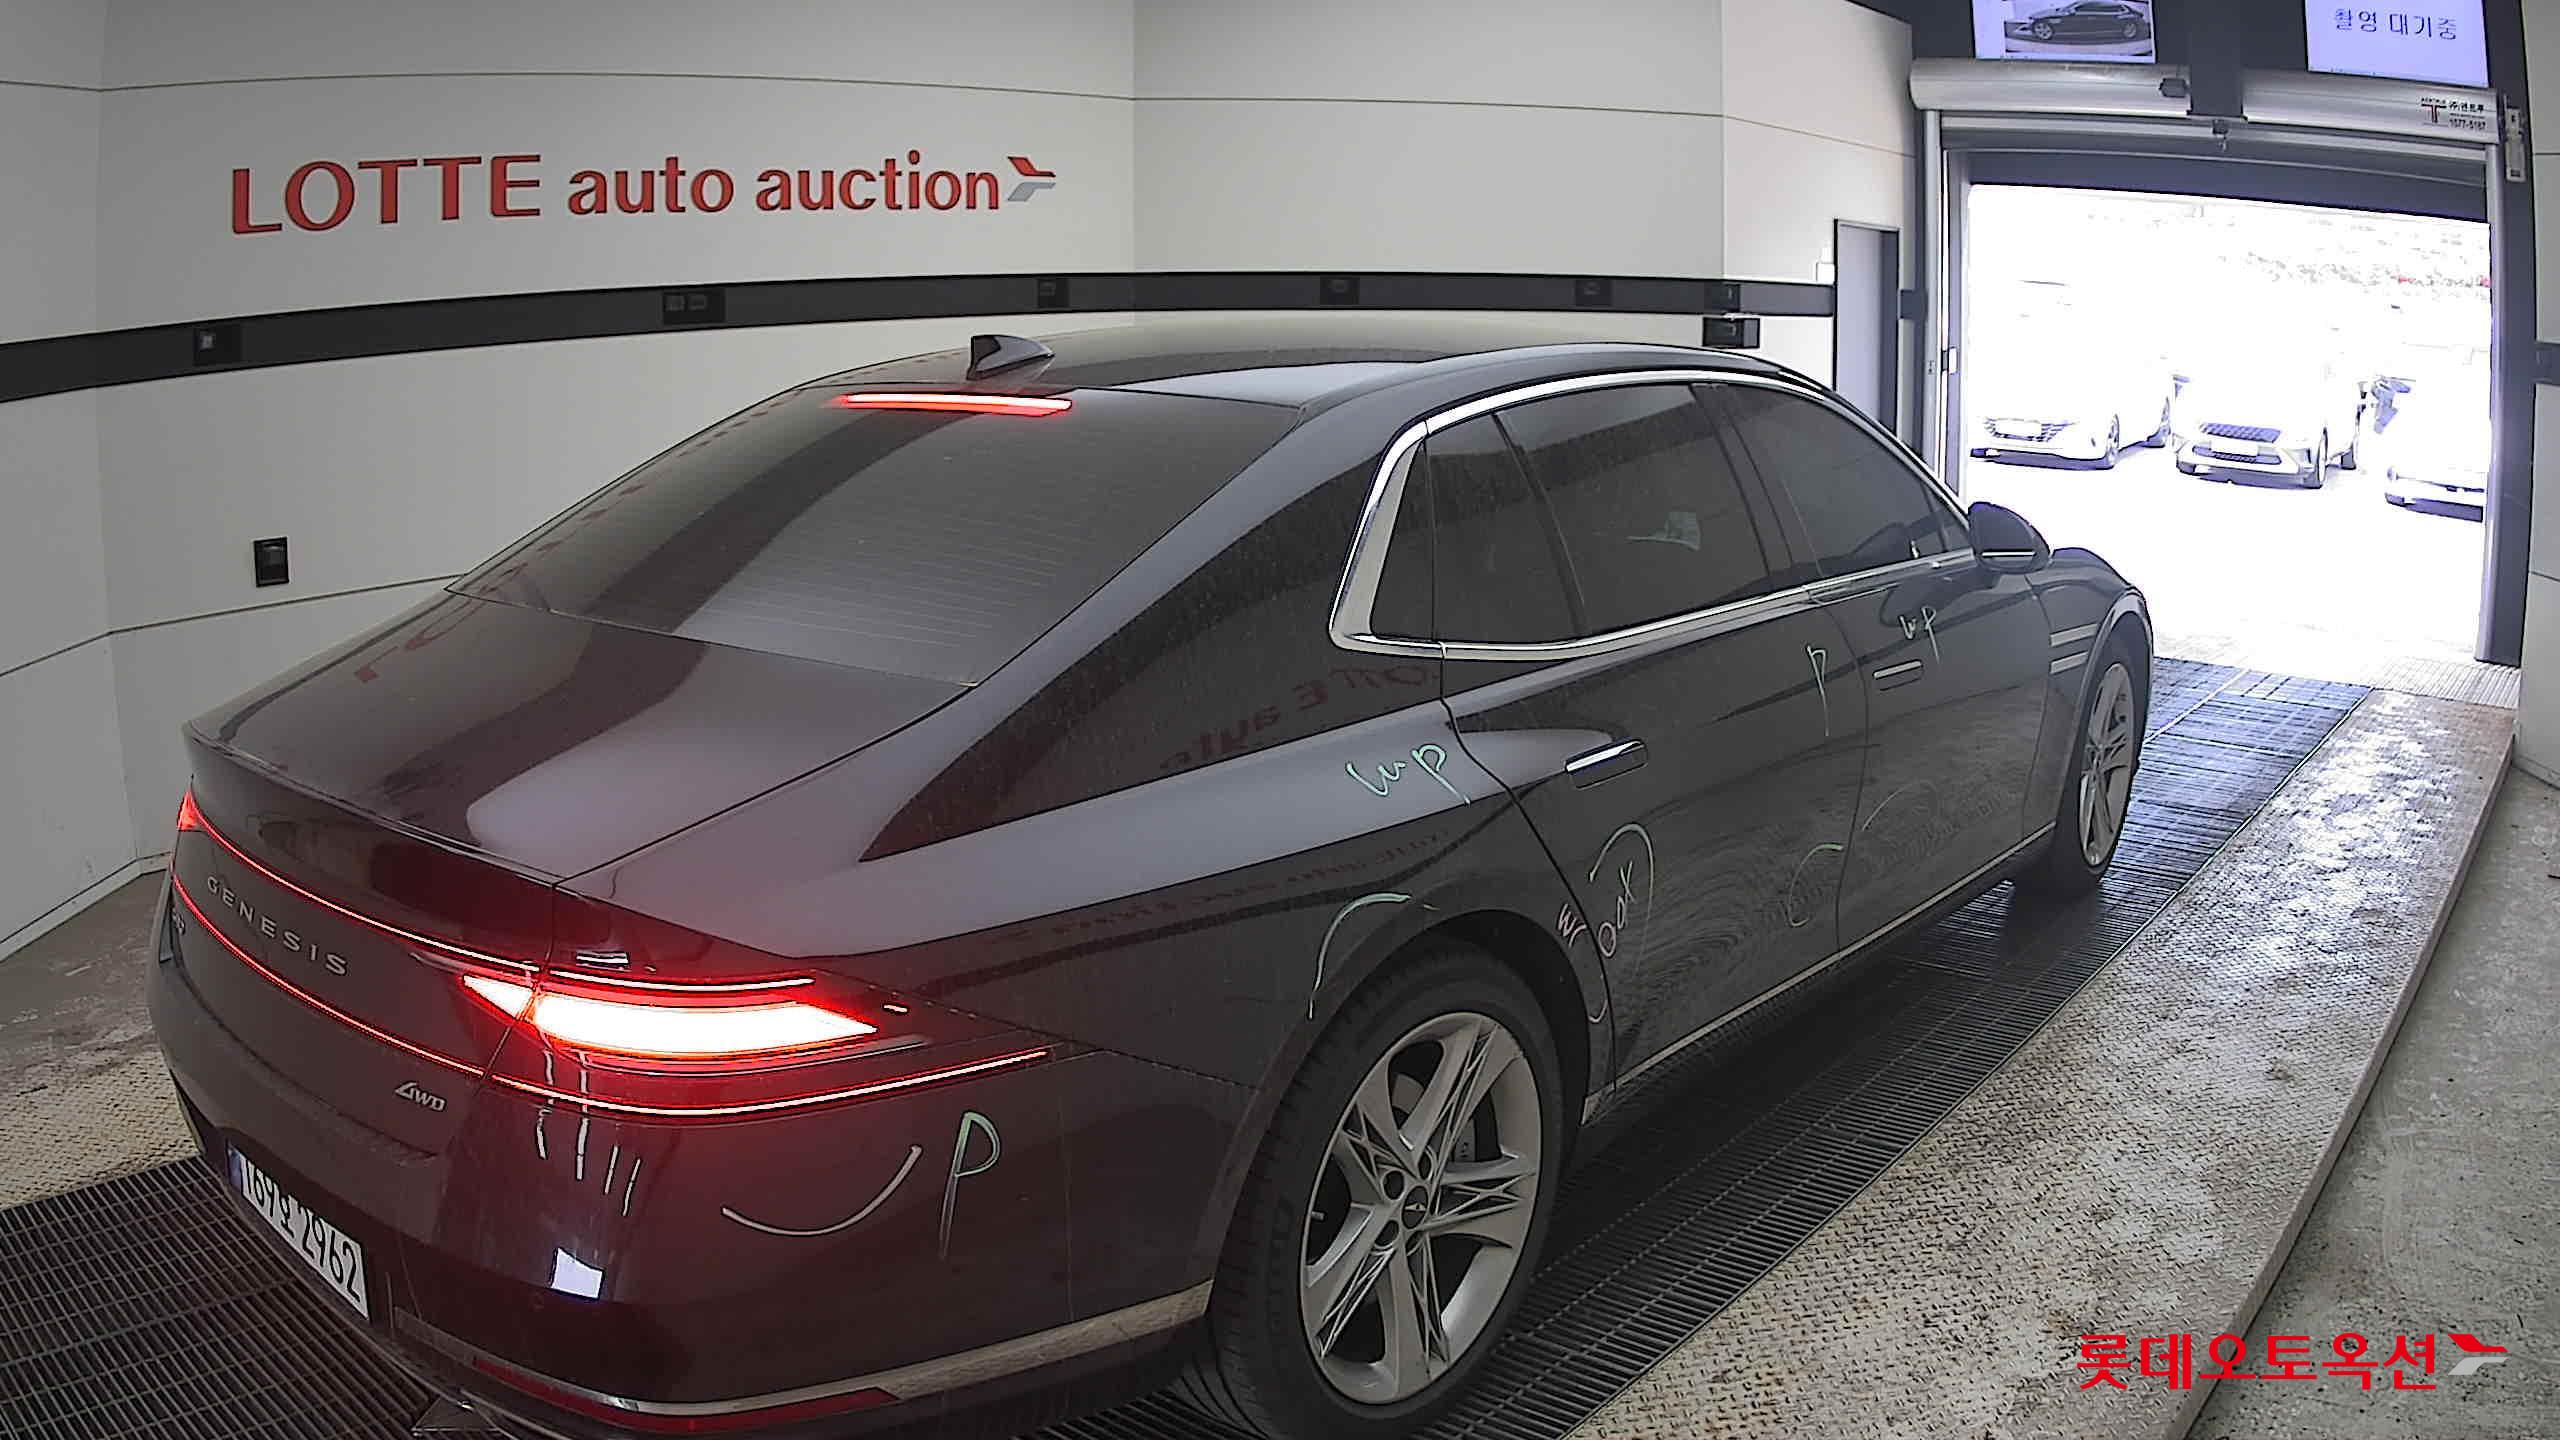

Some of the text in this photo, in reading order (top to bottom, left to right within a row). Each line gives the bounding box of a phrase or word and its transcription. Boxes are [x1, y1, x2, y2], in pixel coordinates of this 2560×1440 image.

[2334, 8, 2457, 40] 촬영 대기중
[231, 149, 1001, 235] LOTTE auto auction
[207, 875, 348, 976] GENESIS
[394, 1081, 446, 1111] 4WD
[298, 1204, 361, 1303] 2962
